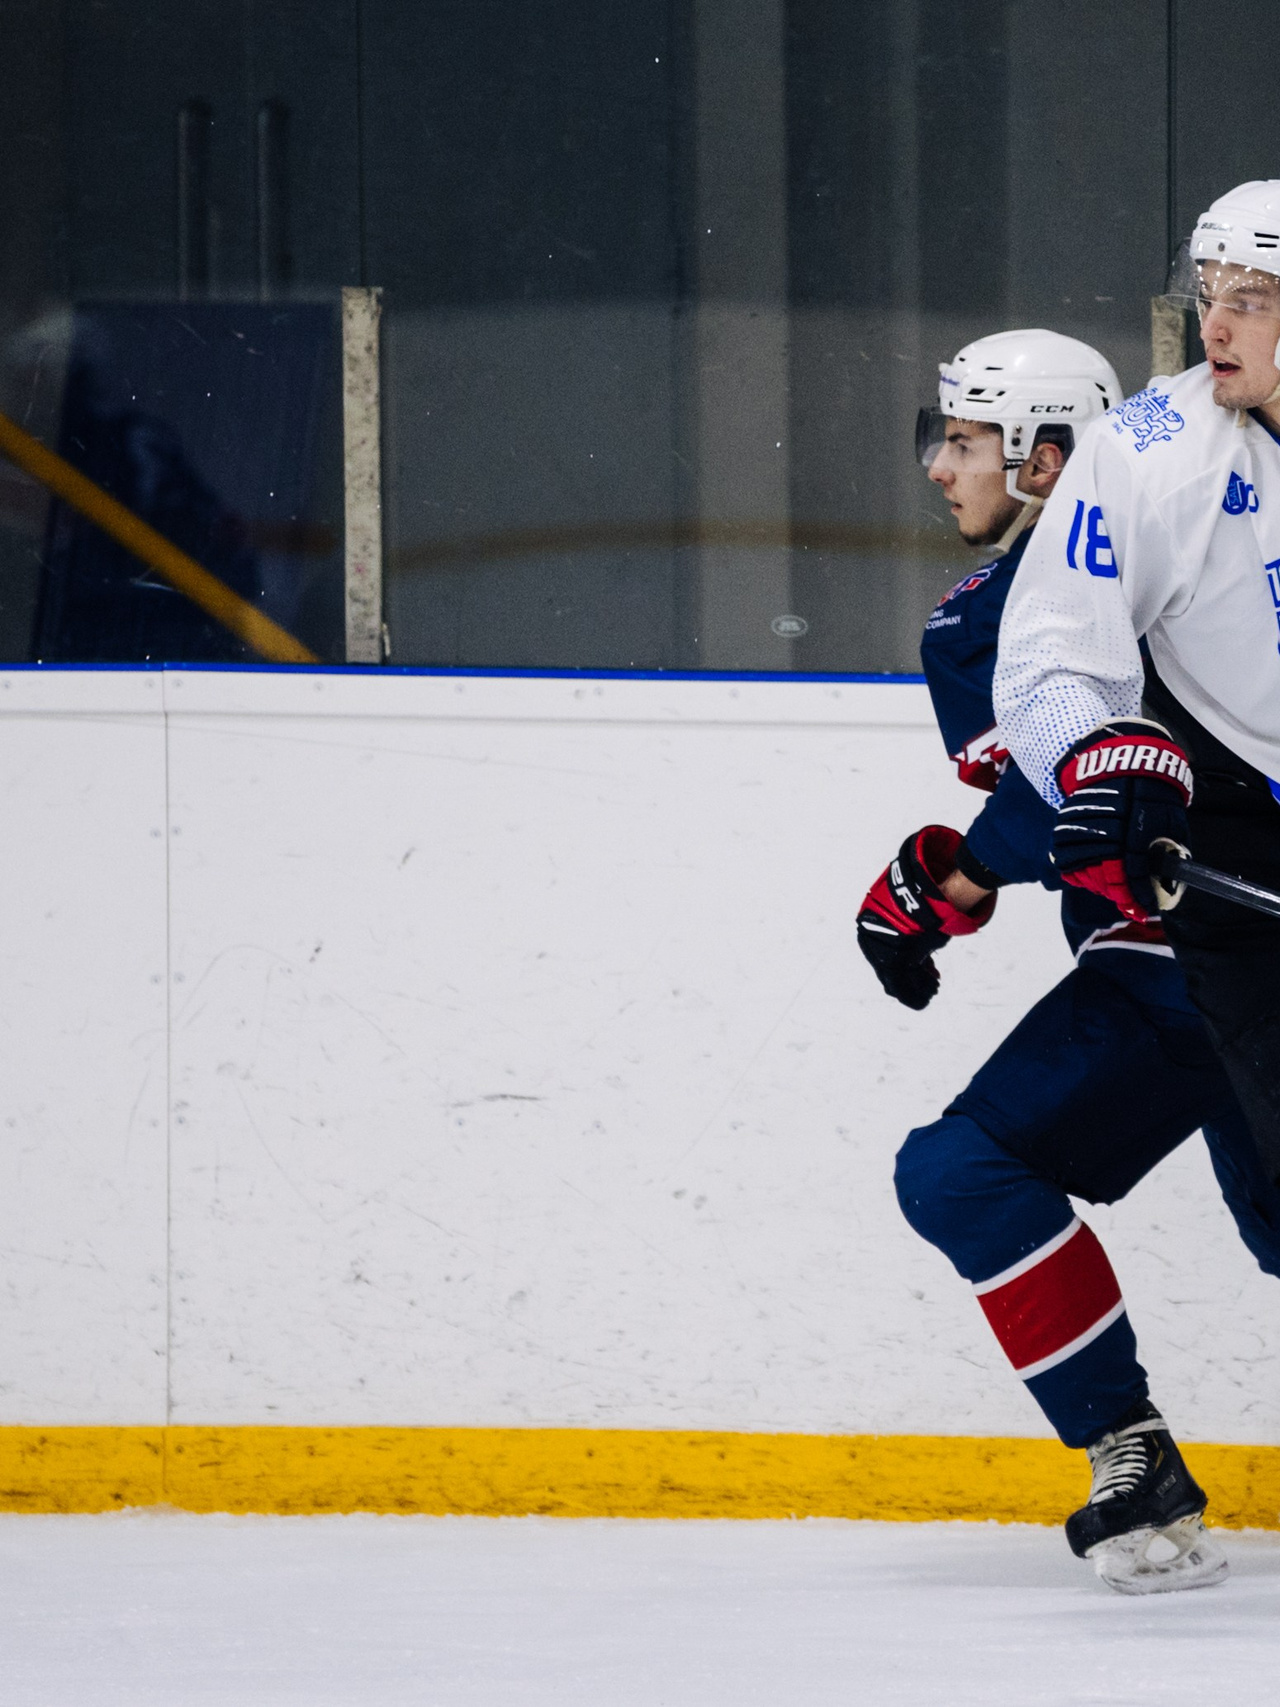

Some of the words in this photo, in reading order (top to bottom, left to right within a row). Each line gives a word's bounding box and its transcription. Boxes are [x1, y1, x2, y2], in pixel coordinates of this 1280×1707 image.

[1030, 405, 1074, 413] CCM
[1066, 499, 1119, 578] 18
[925, 615, 961, 630] COMPANY
